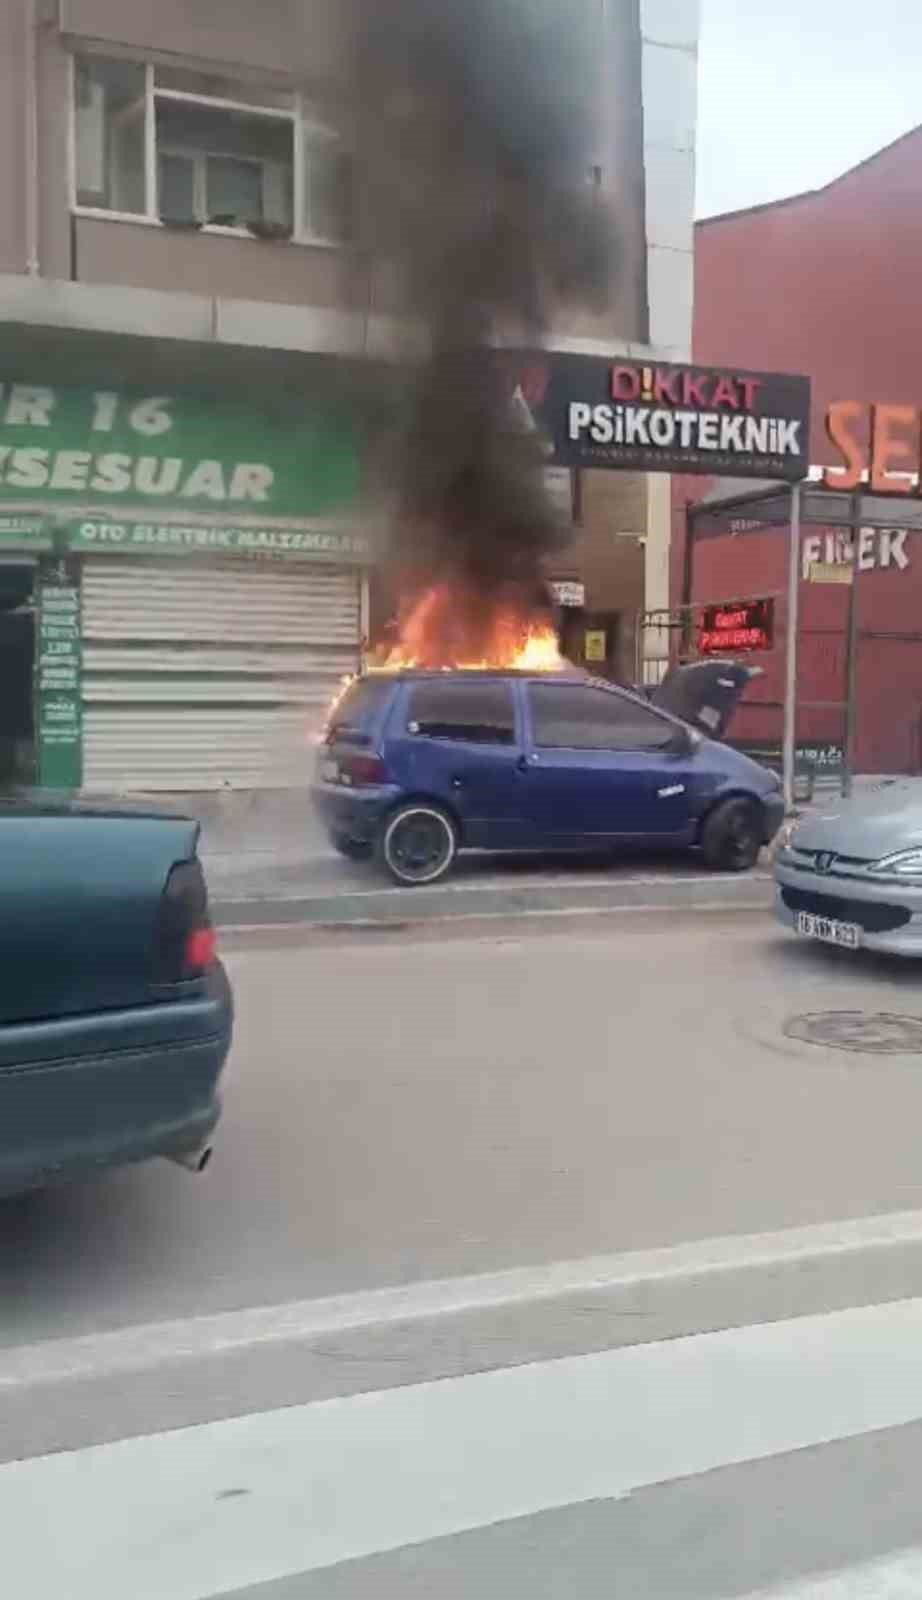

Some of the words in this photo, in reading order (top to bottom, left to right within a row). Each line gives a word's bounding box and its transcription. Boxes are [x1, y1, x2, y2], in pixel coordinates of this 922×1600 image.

[0, 382, 53, 426] R
[92, 392, 172, 436] 16
[823, 401, 922, 492] SE
[80, 522, 125, 541] OTO
